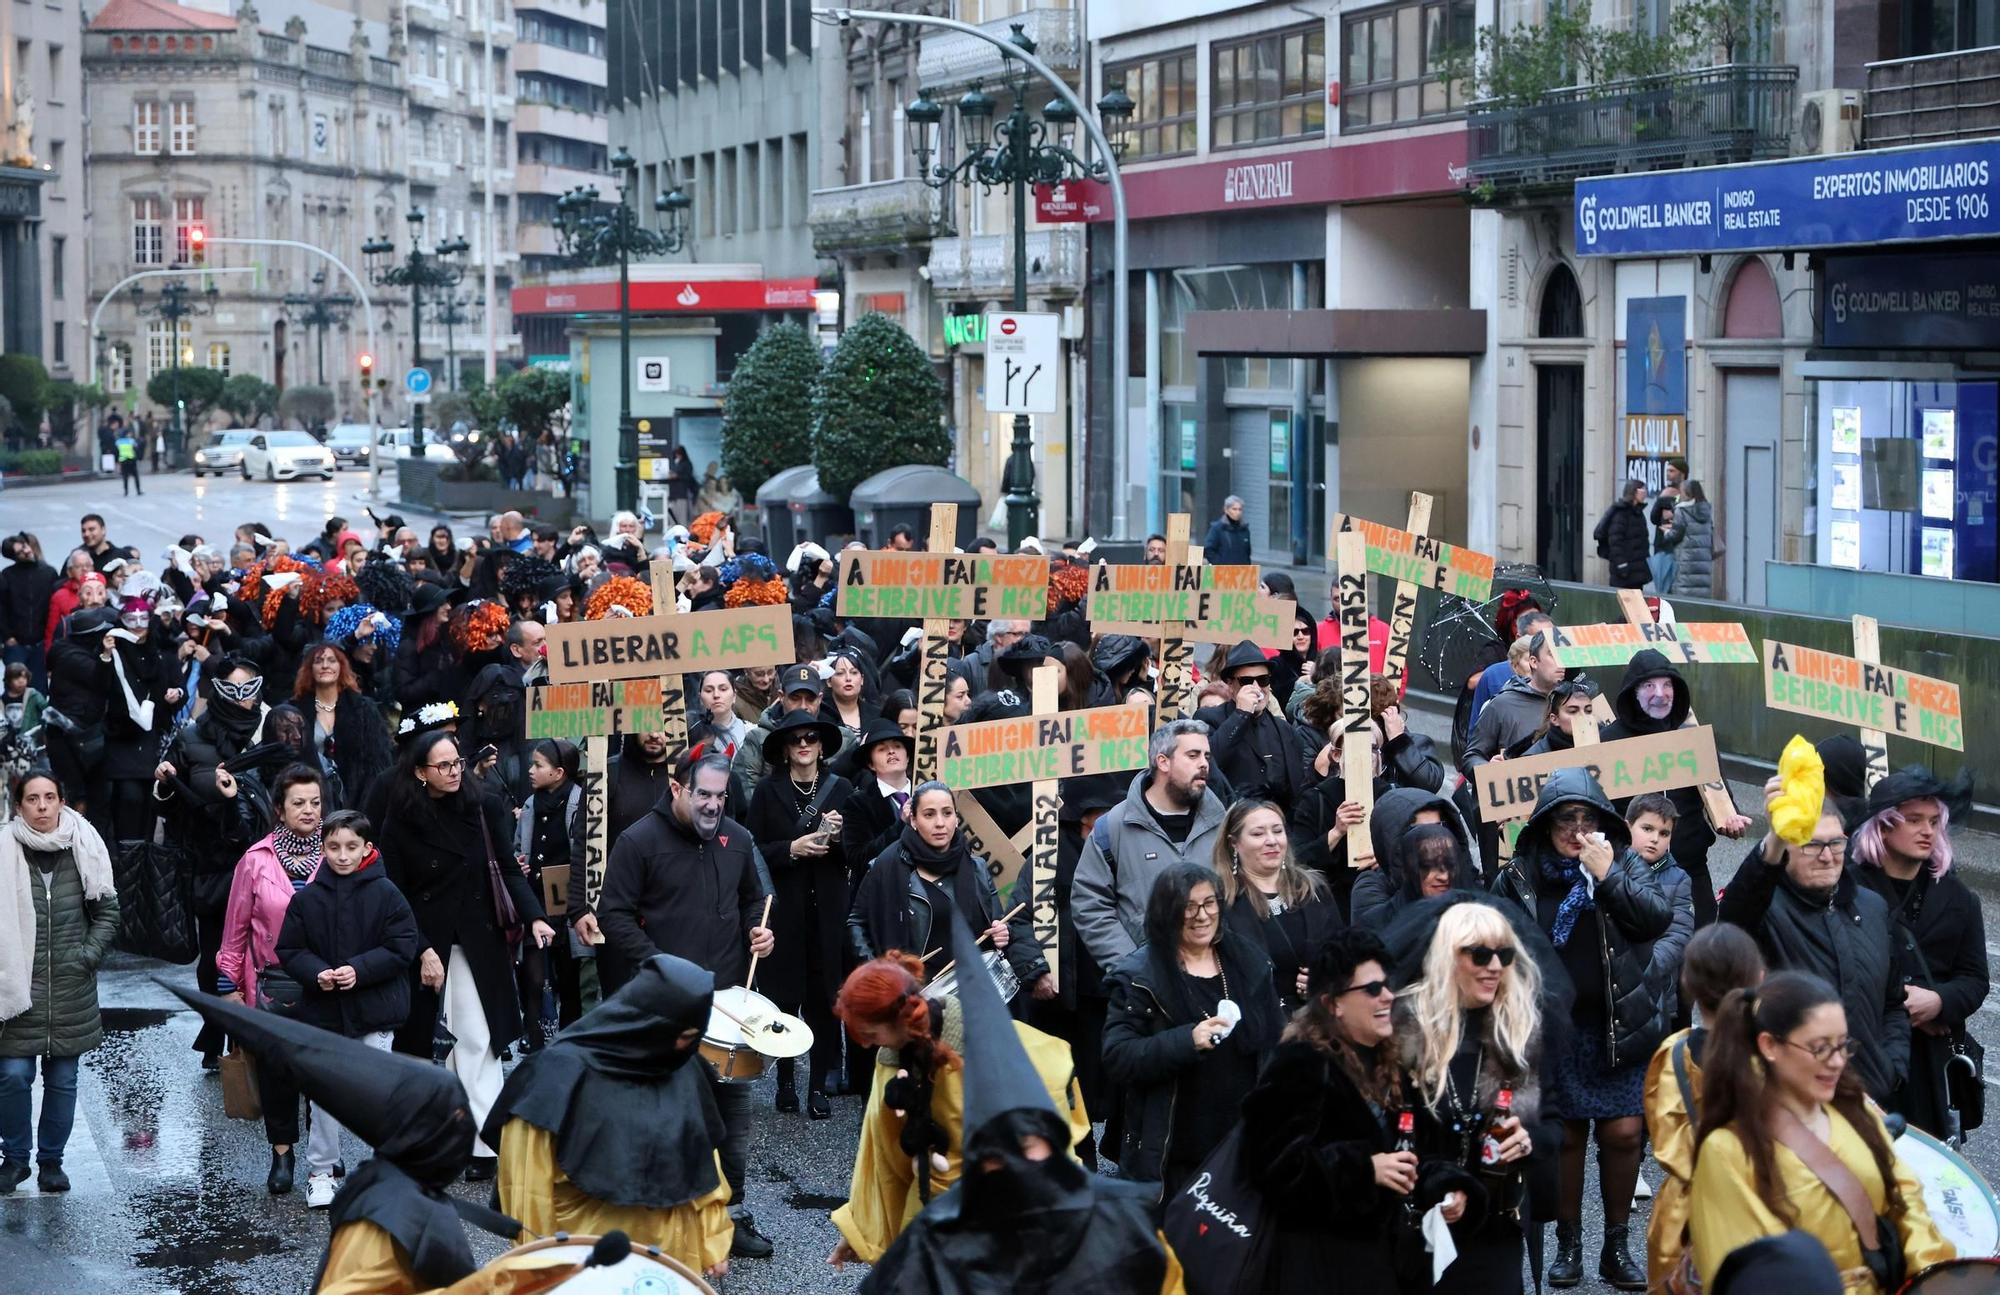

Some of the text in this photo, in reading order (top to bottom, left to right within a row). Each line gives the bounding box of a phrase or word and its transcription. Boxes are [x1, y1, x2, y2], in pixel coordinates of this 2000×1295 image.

[1234, 161, 1292, 201] GENERALI
[1814, 160, 1988, 199] EXPERTOS INMOBILIARIOS
[1724, 190, 1755, 208] INDIGO
[1907, 193, 1988, 223] DESDE 1906
[1600, 204, 1662, 231] COLDWELL
[1664, 201, 1711, 227] BANKER
[1724, 210, 1780, 230] REAL ESTATE
[1850, 292, 1909, 312] COLDWELL
[1912, 290, 1960, 312] BANKER
[1628, 419, 1680, 452] ALQUILA
[1414, 535, 1440, 562] FAI
[847, 558, 864, 586] A
[871, 560, 940, 586] UNION
[944, 558, 976, 586] FAI
[1095, 566, 1109, 592] A
[1116, 566, 1173, 592] UNION
[1174, 565, 1200, 590] FAI
[1435, 566, 1447, 590] E
[846, 587, 962, 616] BEMBRIVE
[974, 587, 988, 616] E
[1093, 592, 1190, 621] BEMBRIVE
[1198, 594, 1210, 620] E
[1388, 593, 1414, 658] NON
[1552, 626, 1571, 648] A
[1572, 624, 1642, 646] UNION
[1641, 622, 1678, 642] FAI
[562, 632, 680, 668] LIBERAR
[691, 628, 712, 657] A
[1680, 643, 1700, 664] E
[800, 668, 808, 680] B
[922, 636, 949, 705] NON
[1160, 638, 1182, 708] NON
[1772, 642, 1789, 672] A
[1795, 648, 1860, 690] UNION
[1864, 664, 1894, 698] FAI
[532, 686, 542, 711] A
[546, 686, 589, 711] UNION
[592, 682, 614, 708] FAI
[1343, 660, 1371, 734] NON
[1772, 671, 1884, 727] BEMBRIVE
[1895, 702, 1906, 732] E
[530, 708, 605, 738] BEMBRIVE
[613, 708, 622, 735] E
[946, 730, 962, 758] A
[968, 722, 1034, 756] UNION
[1039, 718, 1071, 746] FAI
[944, 748, 1058, 788] BEMBRIVE
[1071, 744, 1085, 774] E
[1614, 760, 1634, 788] A
[586, 772, 604, 840] NON
[1034, 878, 1058, 950] NON
